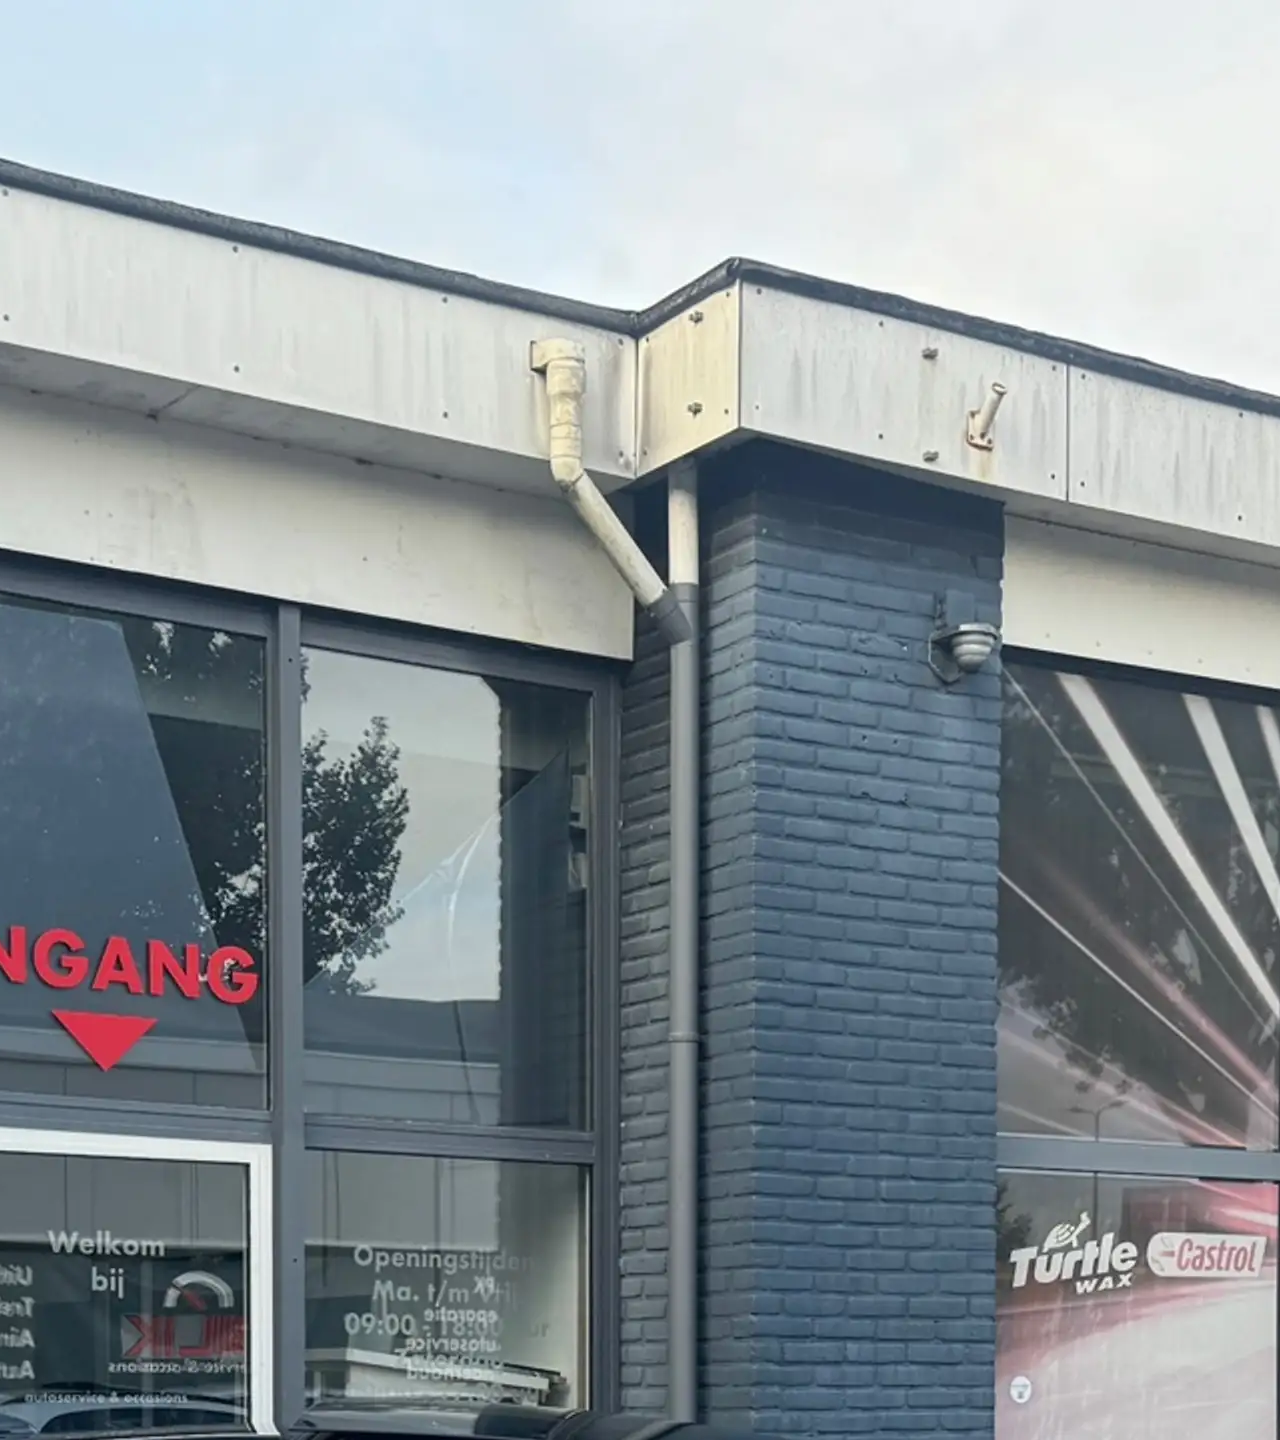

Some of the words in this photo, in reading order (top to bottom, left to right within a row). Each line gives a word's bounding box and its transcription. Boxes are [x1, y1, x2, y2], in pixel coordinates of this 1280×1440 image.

[47, 1229, 166, 1257] Welkom
[1176, 1238, 1257, 1272] Castrol
[1009, 1232, 1138, 1288] Turtle
[91, 1265, 125, 1300] bij
[373, 1279, 420, 1302] Ma.
[427, 1280, 470, 1308] t/m
[1075, 1271, 1134, 1295] WAX
[344, 1312, 416, 1336] 09:00
